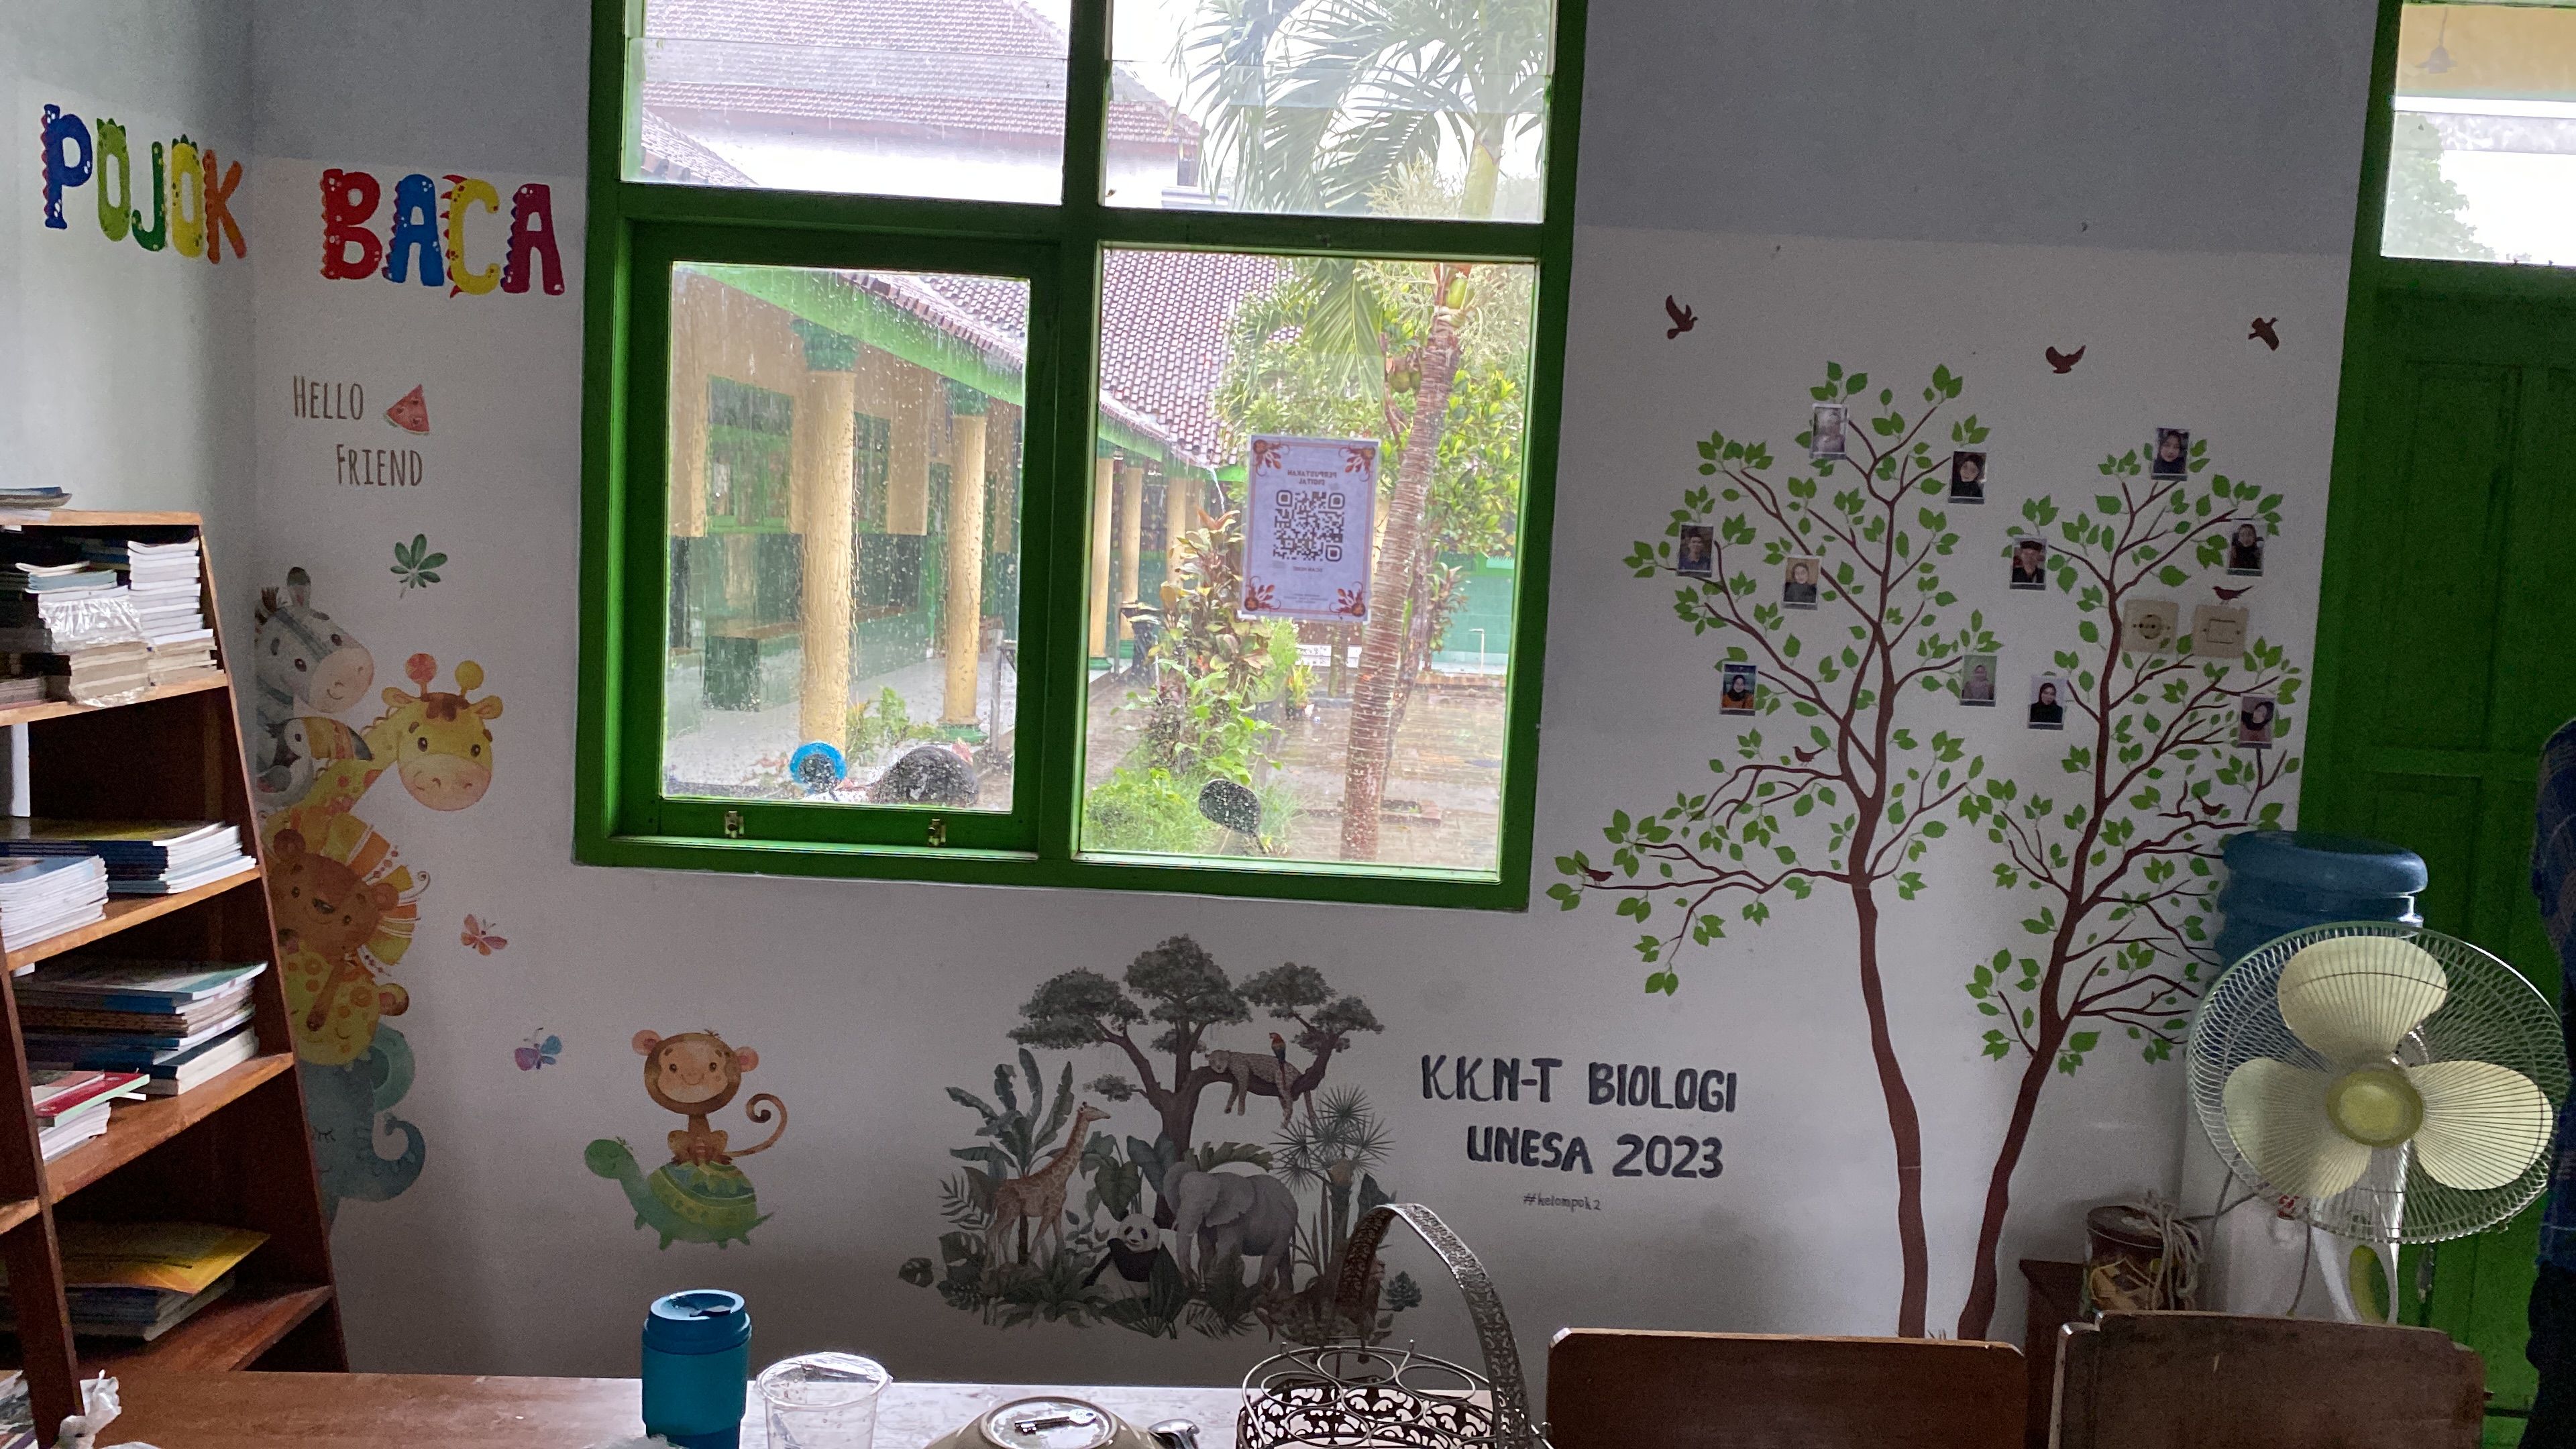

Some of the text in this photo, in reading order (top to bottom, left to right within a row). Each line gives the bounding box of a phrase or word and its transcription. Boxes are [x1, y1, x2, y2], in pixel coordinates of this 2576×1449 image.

[42, 104, 565, 299] POJOK BACA
[292, 376, 364, 421] HELLO
[336, 444, 423, 487] FRIEND
[1421, 1054, 1737, 1113] KKN-T BIOLOGI
[1467, 1126, 1723, 1179] UNESA 2023
